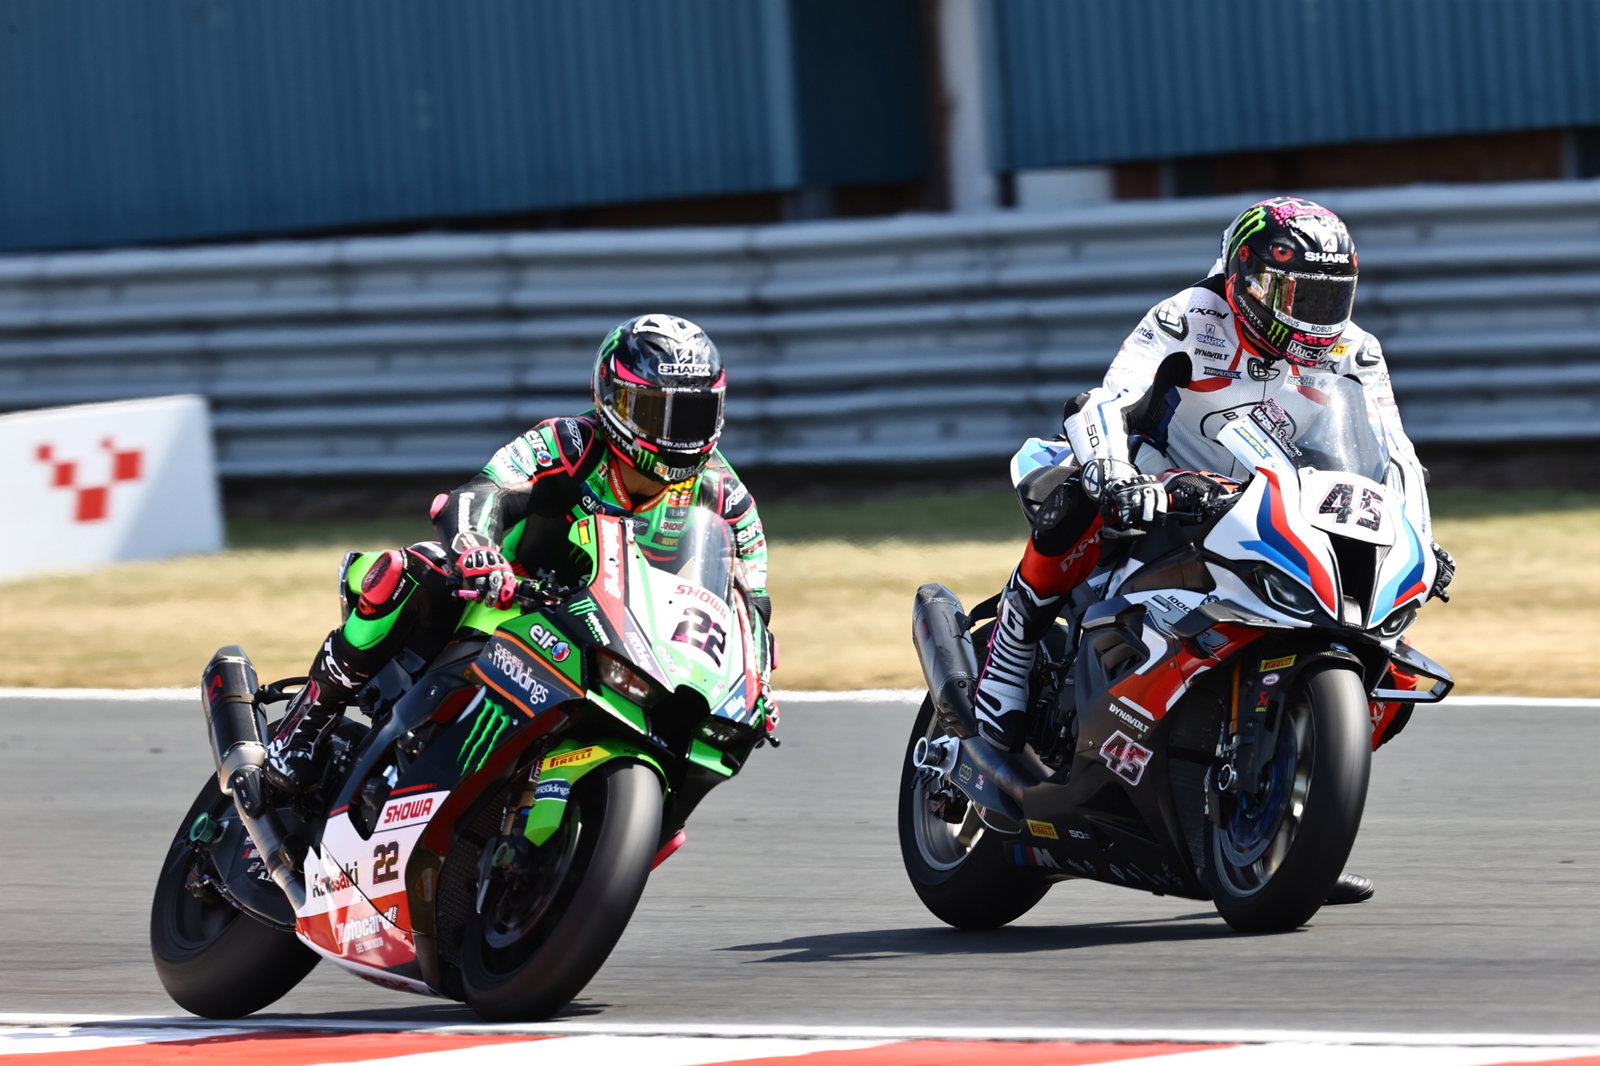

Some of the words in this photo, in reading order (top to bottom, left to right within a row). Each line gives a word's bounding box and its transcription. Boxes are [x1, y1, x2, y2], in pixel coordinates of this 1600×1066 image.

[1304, 251, 1350, 264] SHARK
[1276, 312, 1300, 328] ROBUS
[1310, 324, 1333, 333] ROBUS
[1196, 333, 1227, 348] SHARK
[1194, 348, 1231, 361] DYNAVOLT
[659, 364, 710, 376] SHARK
[1205, 368, 1239, 379] RAVENOL
[525, 430, 548, 453] elf
[1318, 481, 1384, 532] 45
[529, 623, 557, 649] elf
[671, 607, 727, 668] 22
[493, 651, 549, 705] mouldings
[1109, 703, 1150, 733] DYNAVOLT
[549, 748, 593, 768] PIRELLI
[1099, 729, 1154, 786] 45
[384, 797, 434, 824] SHOWA
[372, 840, 400, 885] 22
[312, 861, 359, 898] Kawasaki
